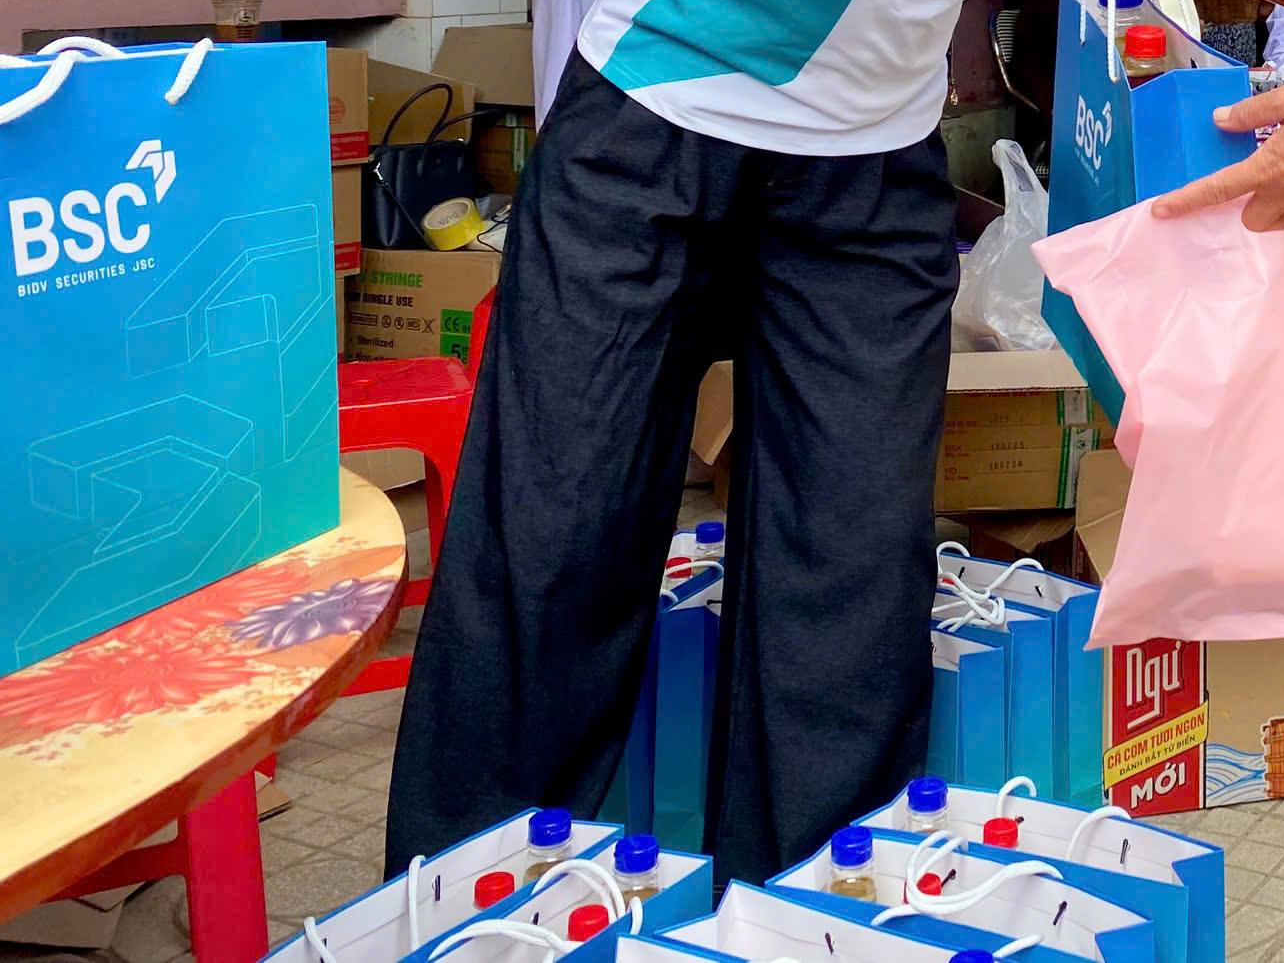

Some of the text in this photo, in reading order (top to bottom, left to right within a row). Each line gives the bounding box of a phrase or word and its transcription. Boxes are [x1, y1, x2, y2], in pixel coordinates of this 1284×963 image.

[1075, 94, 1104, 170] BSC
[8, 182, 151, 277] BSC
[17, 257, 156, 298] BIDV SECURITIES JSC
[371, 270, 423, 288] SYRINGE
[362, 293, 393, 306] SINGLE
[396, 296, 414, 308] USE
[1126, 640, 1182, 730] Ngư
[1175, 712, 1206, 737] NGON
[1130, 760, 1186, 809] MỚI
